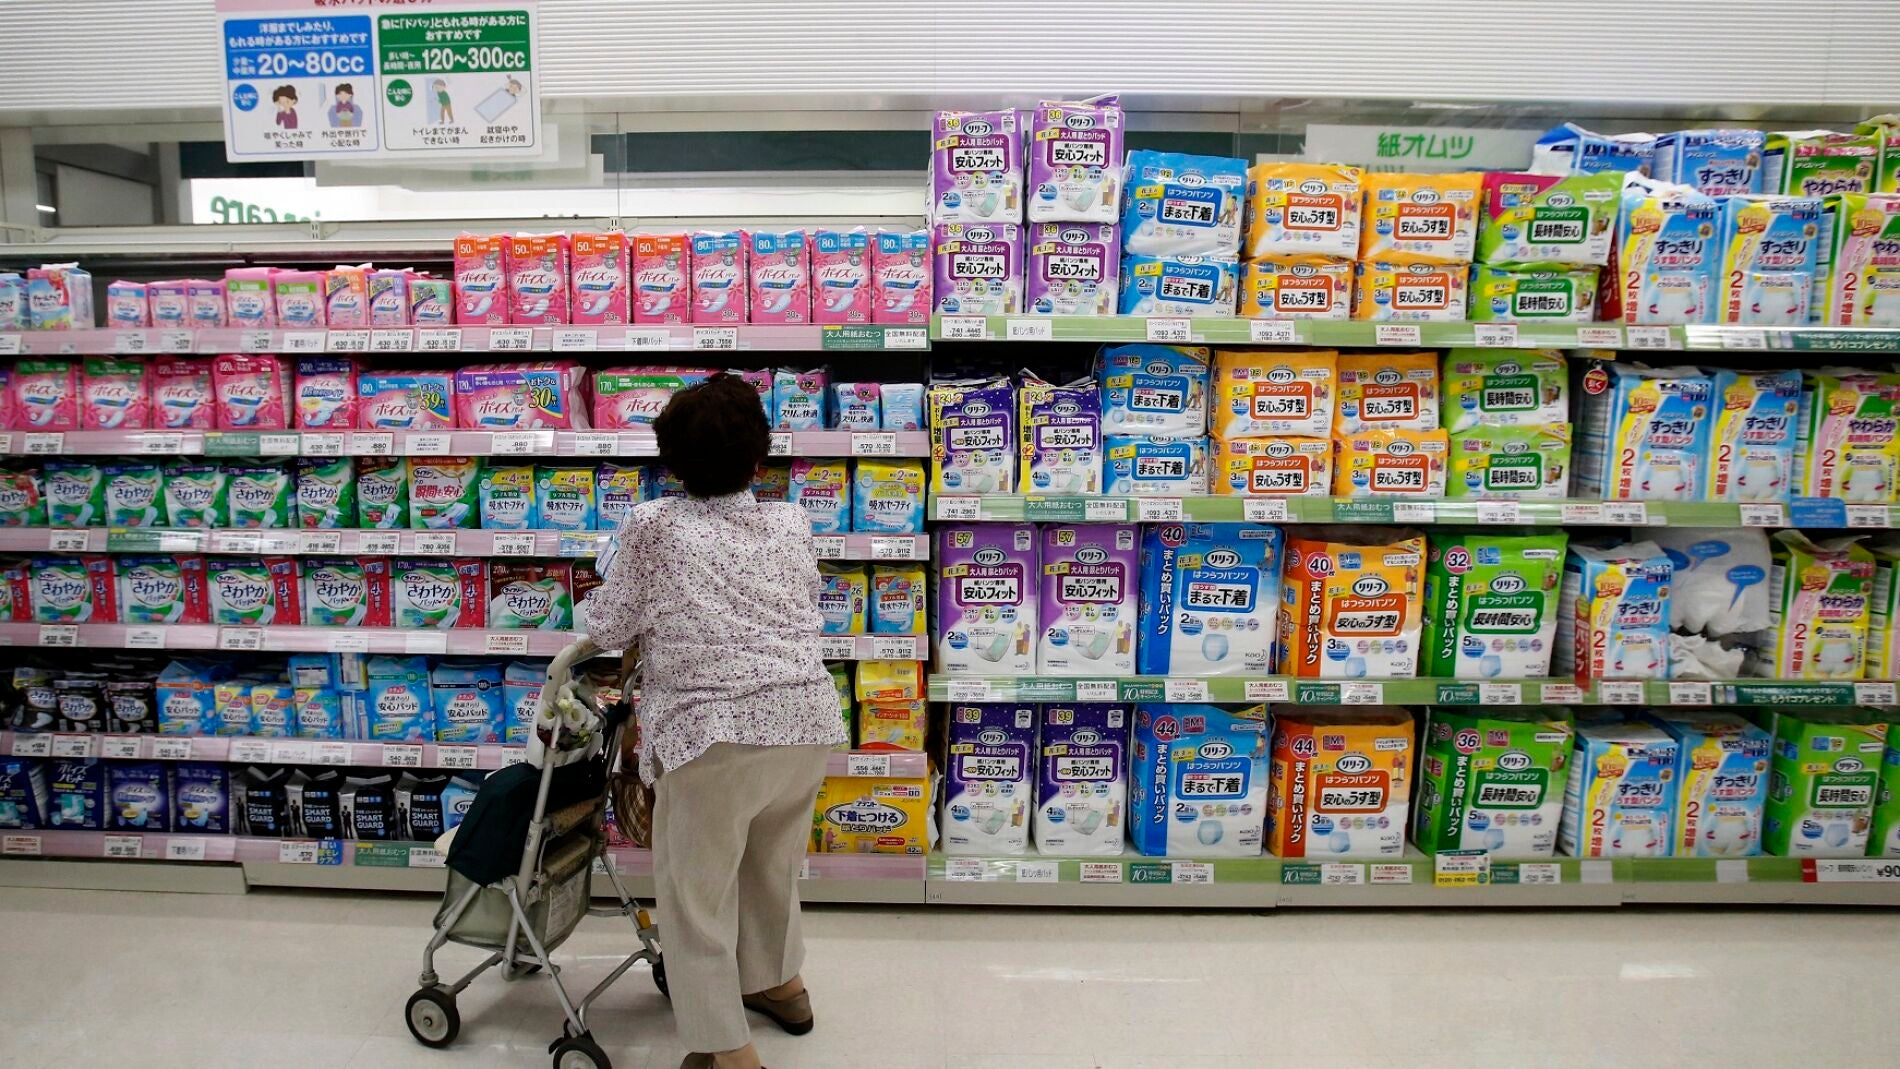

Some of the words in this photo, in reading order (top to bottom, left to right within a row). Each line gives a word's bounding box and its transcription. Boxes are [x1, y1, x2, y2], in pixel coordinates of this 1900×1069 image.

[229, 34, 368, 47] もれる時がある方におすすめです
[425, 30, 481, 40] おすすめです
[321, 129, 366, 138] 外出や旅行で
[412, 127, 468, 136] トイレまでがまん
[330, 138, 360, 147] 心配な時
[422, 136, 460, 145] できない時
[1377, 132, 1474, 159] 紙オムツ
[956, 156, 1003, 169] 安心フィット
[1055, 150, 1103, 163] 安心フィット
[1699, 170, 1750, 185] すっきり
[1164, 204, 1213, 221] まるで下着
[1289, 209, 1337, 226] 安心のうす型
[1401, 218, 1448, 235] 安心のうす型
[1534, 221, 1579, 238] 長時間安心
[1655, 240, 1701, 254] すっきり
[1760, 240, 1806, 254] すっきり
[957, 263, 1003, 276] 安心フィット
[1051, 264, 1097, 277] 安心フィット
[1164, 281, 1210, 298] まるで下着
[1398, 288, 1443, 303] 安心のうす型
[1281, 291, 1326, 306] 安心のうす型
[1133, 394, 1179, 409] まるで下着
[1257, 398, 1305, 414] 安心のうす型
[1486, 392, 1532, 407] 長時間安心
[1366, 400, 1412, 416] 安心のうす型
[1651, 420, 1694, 433] すっきり
[1745, 417, 1786, 430] すっきり
[1847, 419, 1895, 432] やわらか
[965, 435, 1001, 446] 安心フィット
[1054, 435, 1091, 445] 安心フィット
[1138, 461, 1182, 476] まるで下着
[1255, 472, 1302, 488] 安心のうす型
[1376, 471, 1422, 487] 安心のうす型
[1490, 470, 1536, 485] 長時間安心
[41, 581, 85, 595] さわやか
[132, 581, 178, 595] さわやか
[220, 584, 267, 598] さわやか
[316, 584, 362, 598] さわやか
[407, 586, 455, 599] さわやか
[964, 586, 1016, 600] 安心フィット
[1065, 585, 1117, 599] 安心フィット
[1156, 548, 1174, 635] まとめ買いパック
[507, 596, 550, 608] さわやか
[1189, 591, 1248, 607] まるで下着
[1819, 596, 1864, 608] やわらか
[1616, 602, 1660, 616] すっきり
[1306, 580, 1323, 665] まとめ買いパック
[1336, 615, 1398, 629] 安心のうす型
[1442, 575, 1460, 659] まとめ買いパック
[1473, 612, 1531, 626] 長時間安心
[378, 703, 418, 712] 安心パッド
[448, 709, 488, 718] 安心パッド
[977, 764, 1017, 776] 安心フィット
[1071, 765, 1111, 776] 安心フィット
[1153, 743, 1168, 824] まとめ買いパック
[1183, 779, 1240, 794] まるで下着
[1618, 782, 1663, 796] すっきり
[1714, 776, 1757, 788] すっきり
[1323, 789, 1380, 806] 安心のうす型
[1447, 756, 1467, 837] まとめ買いパック
[1480, 788, 1536, 802] 長時間安心
[1290, 762, 1305, 843] まとめ買いパック
[249, 807, 273, 815] SMART
[304, 808, 330, 816] SMART
[356, 814, 383, 822] SMART
[412, 812, 439, 820] SMART
[836, 810, 898, 823] 下着につける
[249, 815, 274, 823] GUARD
[305, 815, 332, 823] GUARD
[413, 819, 439, 827] GUARD
